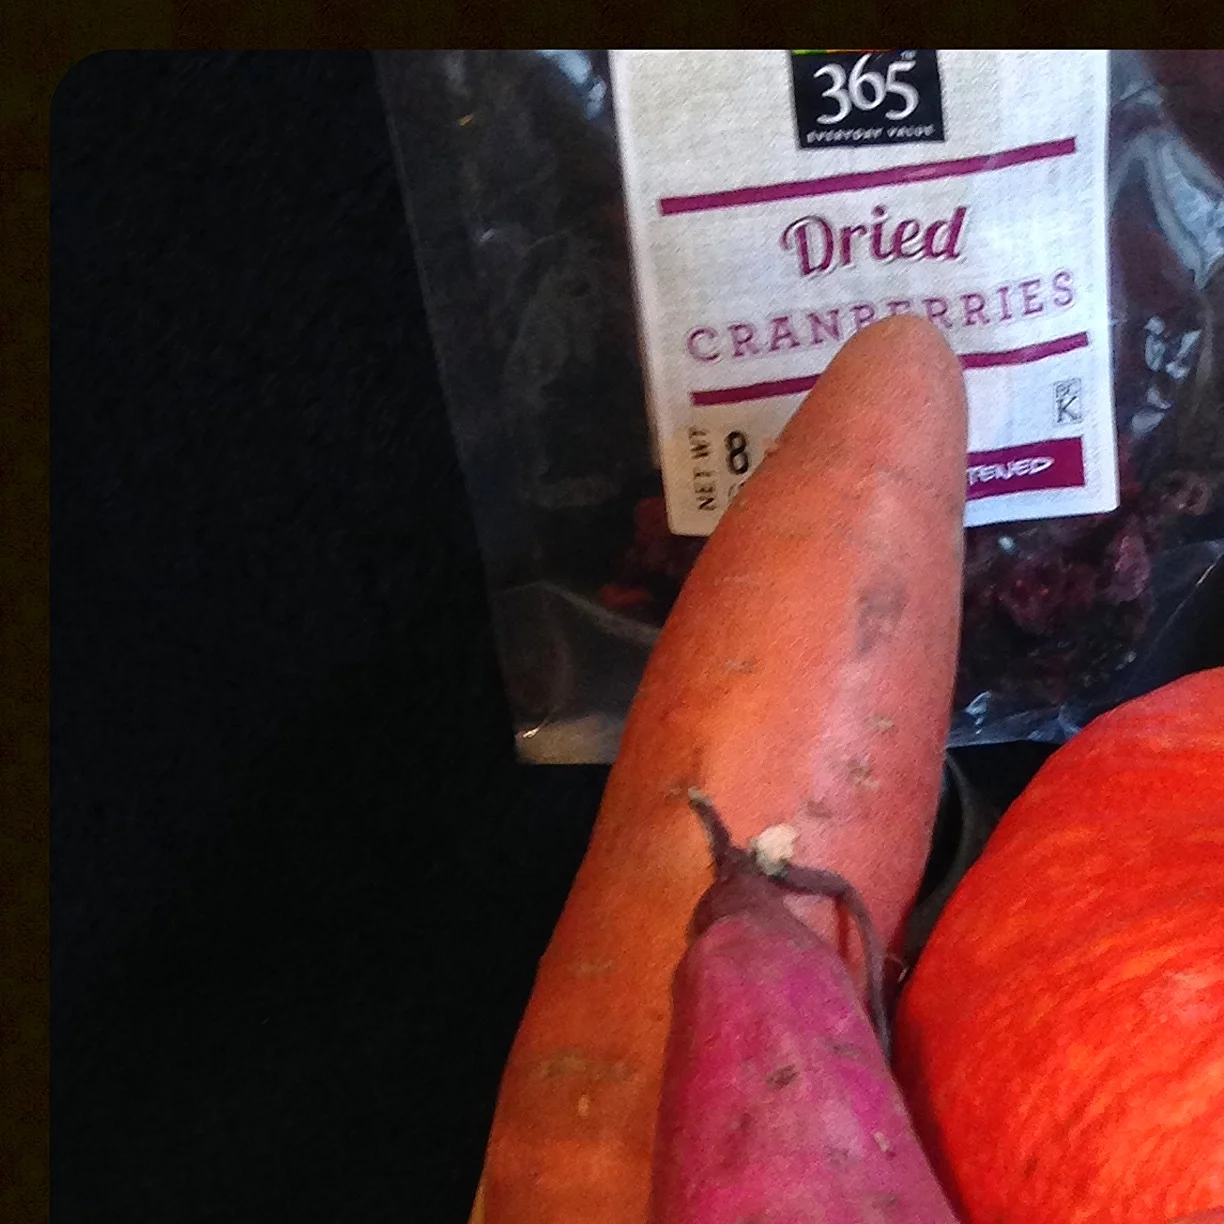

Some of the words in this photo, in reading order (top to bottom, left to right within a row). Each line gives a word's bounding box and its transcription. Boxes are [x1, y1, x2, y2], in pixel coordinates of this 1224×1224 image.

[813, 53, 920, 125] 365
[781, 204, 968, 276] Dried
[724, 430, 749, 476] 8
